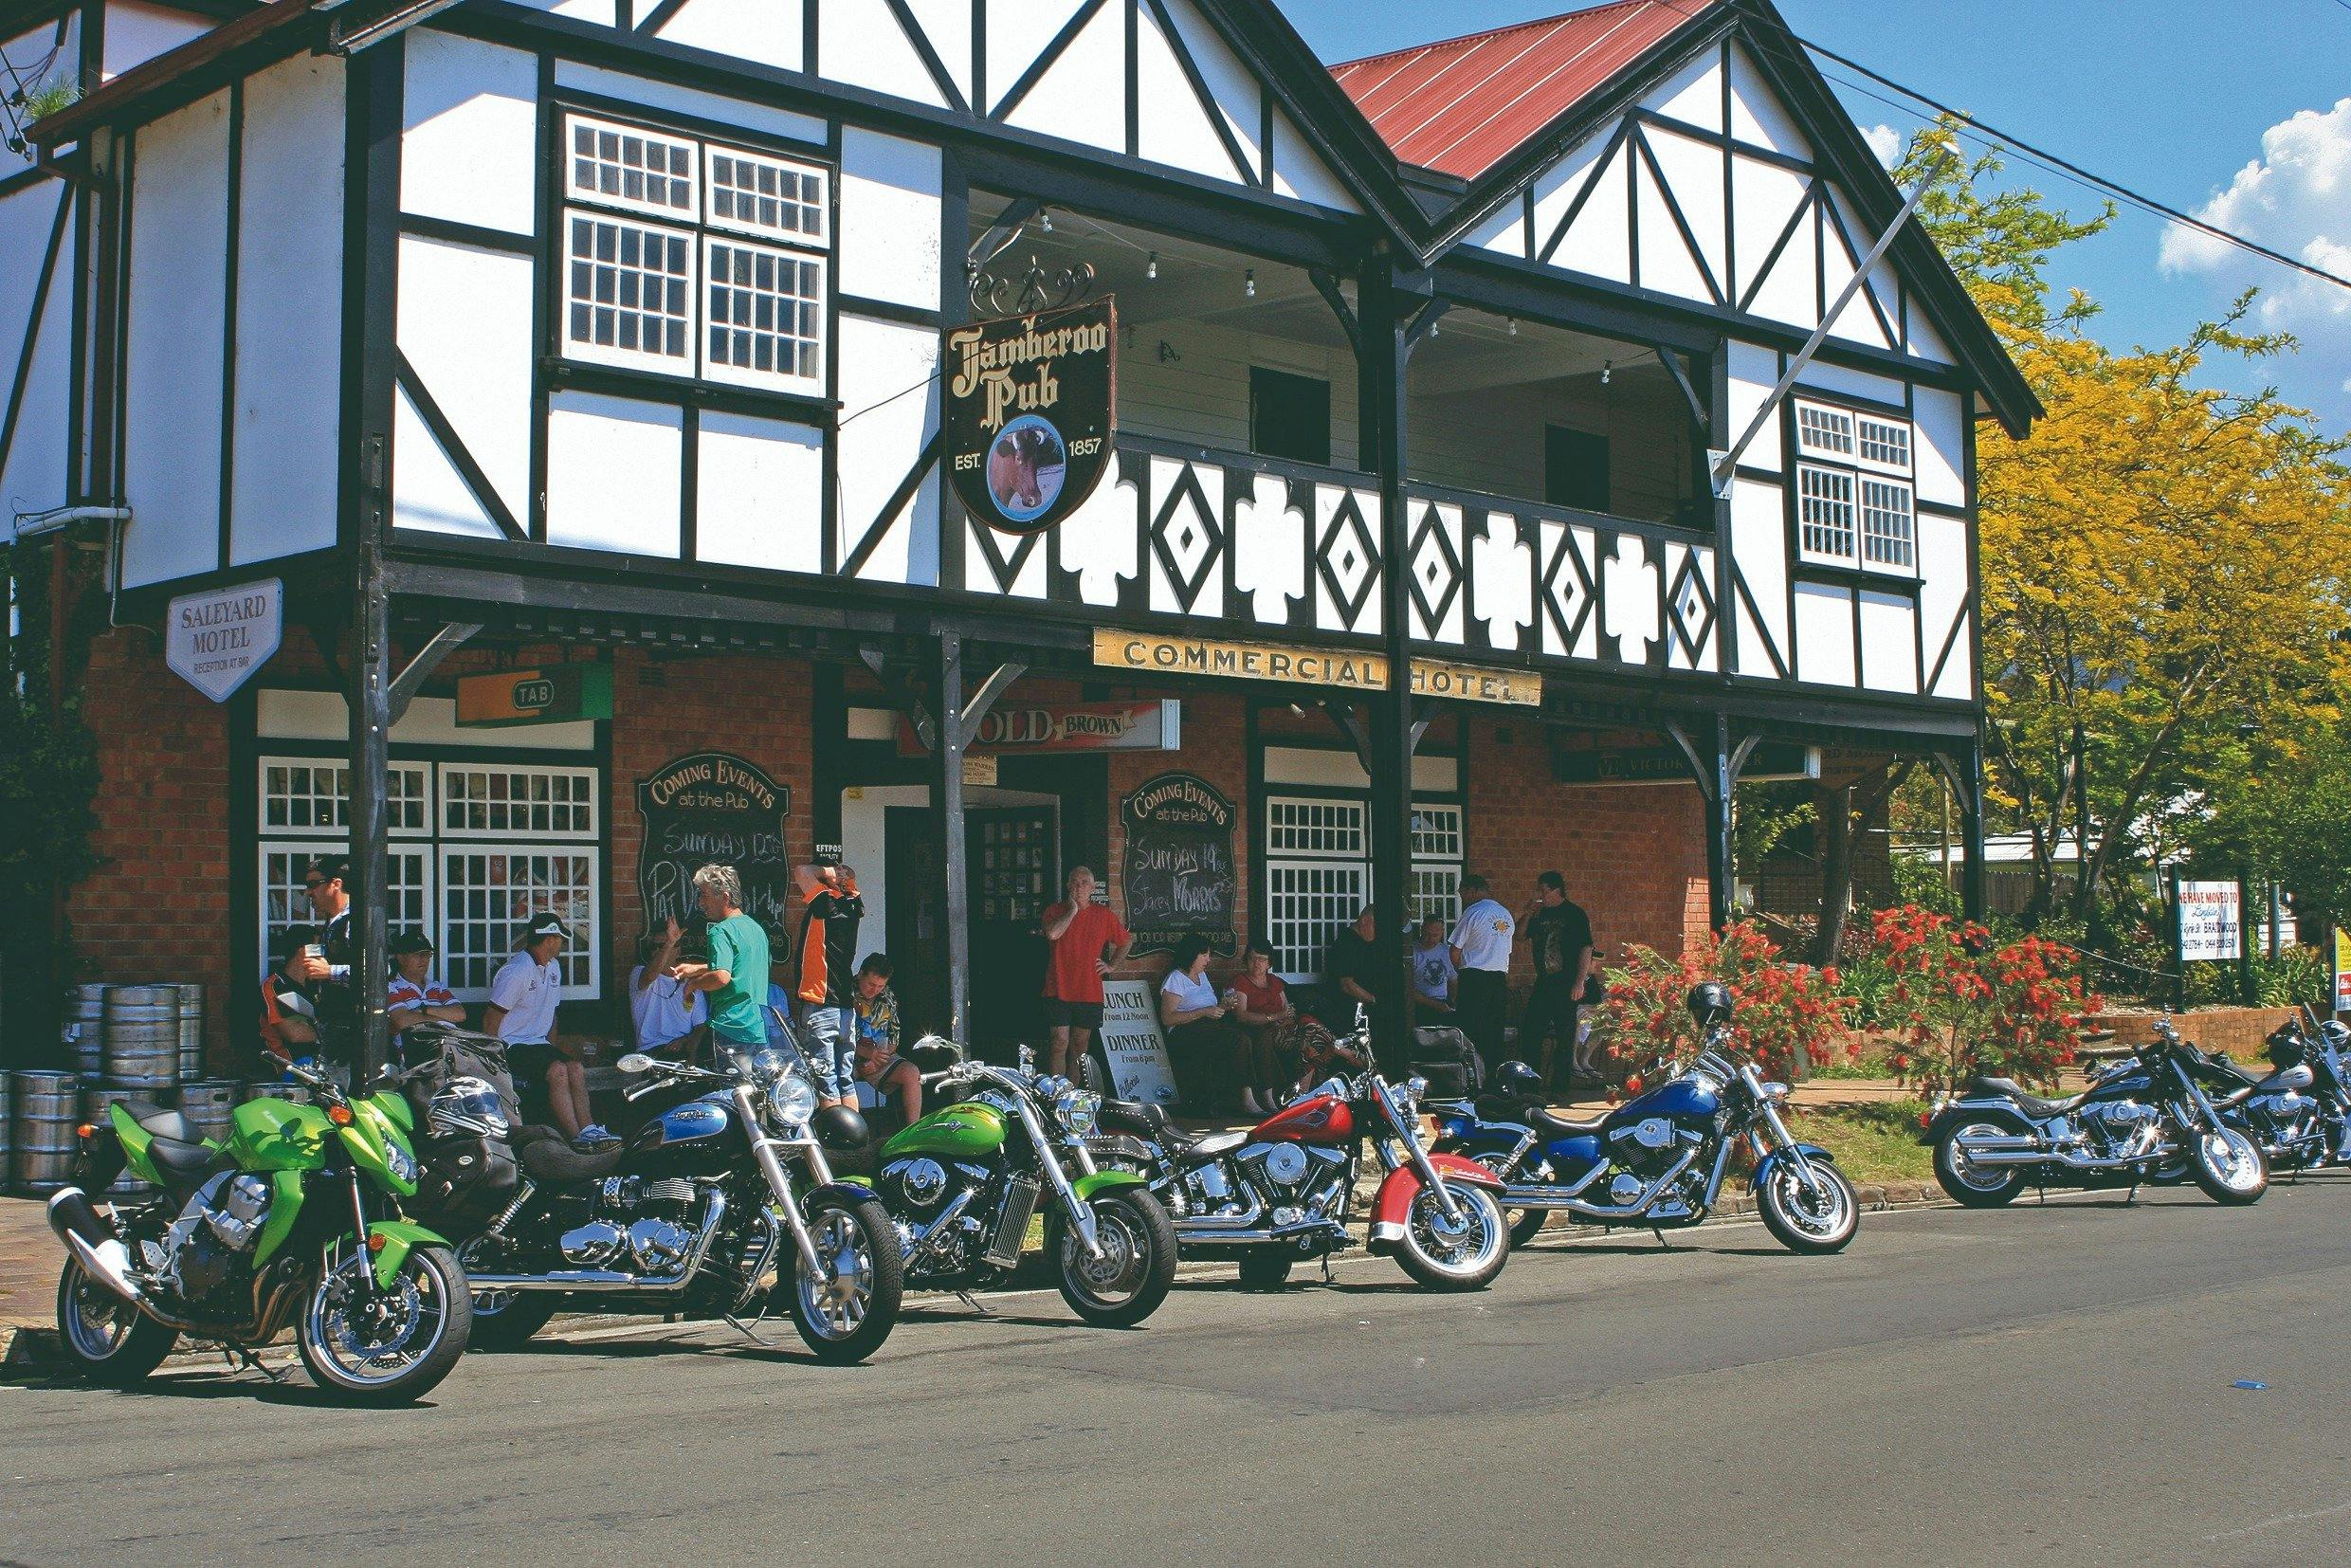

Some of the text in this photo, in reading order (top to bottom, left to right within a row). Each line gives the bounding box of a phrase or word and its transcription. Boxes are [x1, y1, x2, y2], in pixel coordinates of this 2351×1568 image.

[980, 361, 1059, 435] Pub
[955, 438, 1102, 471] EST. 1857
[181, 595, 266, 629] SALEYARD
[192, 627, 251, 654] MOTEL
[193, 659, 228, 675] RECEPTION
[228, 658, 237, 669] AT
[1124, 641, 1383, 685] COMMERCIAL
[519, 687, 548, 703] TAB
[976, 710, 1122, 743] OLD BROWN
[679, 789, 749, 809] at the Pub
[1157, 808, 1208, 822] at the Pub
[816, 844, 842, 853] EFTPOS
[2187, 891, 2204, 903] HAVE
[2205, 891, 2229, 903] MOVED
[2230, 892, 2238, 903] TO
[1131, 1012, 1149, 1021] Noon
[1106, 1033, 1160, 1051] DINNER
[1121, 1054, 1139, 1063] From
